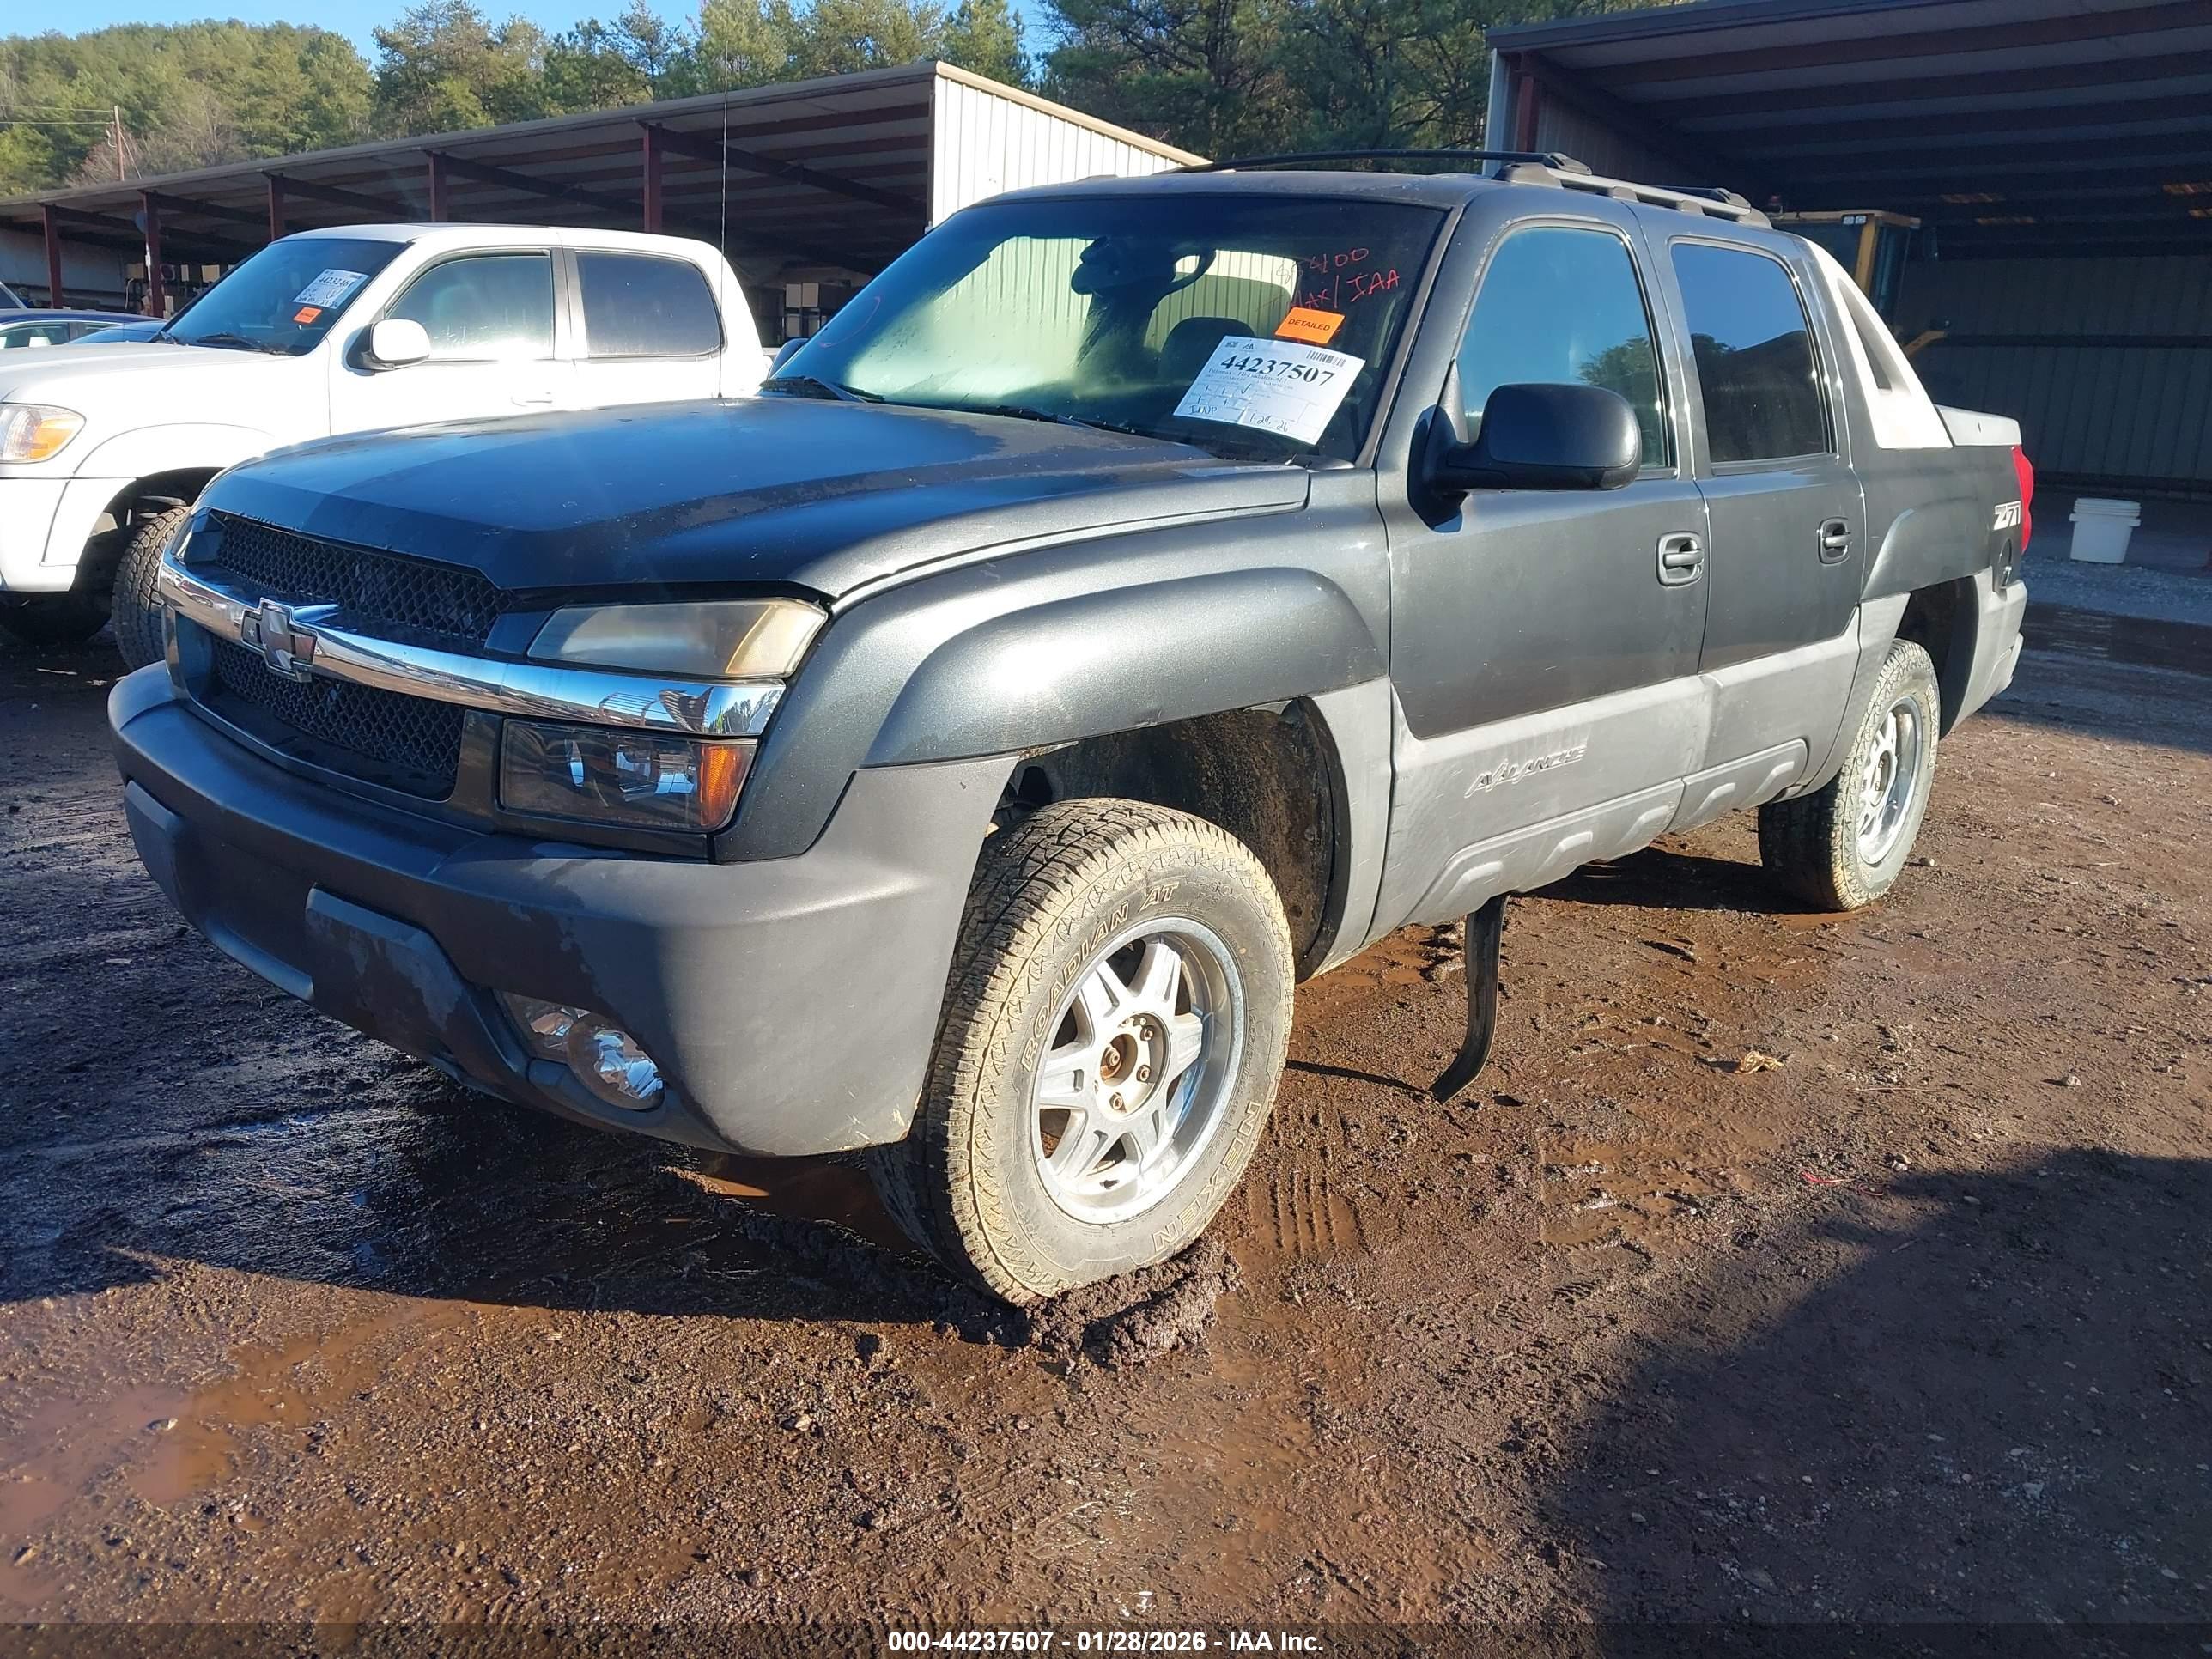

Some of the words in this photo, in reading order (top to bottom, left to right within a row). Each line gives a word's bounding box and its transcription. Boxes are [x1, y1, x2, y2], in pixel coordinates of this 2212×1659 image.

[1288, 318, 1331, 331] DETAILED
[1220, 354, 1335, 386] 44237507
[1993, 501, 2021, 530] Z71
[1020, 900, 1131, 1072] ROADIAN
[1139, 881, 1180, 913] AT
[1152, 1101, 1262, 1253] NEXEN
